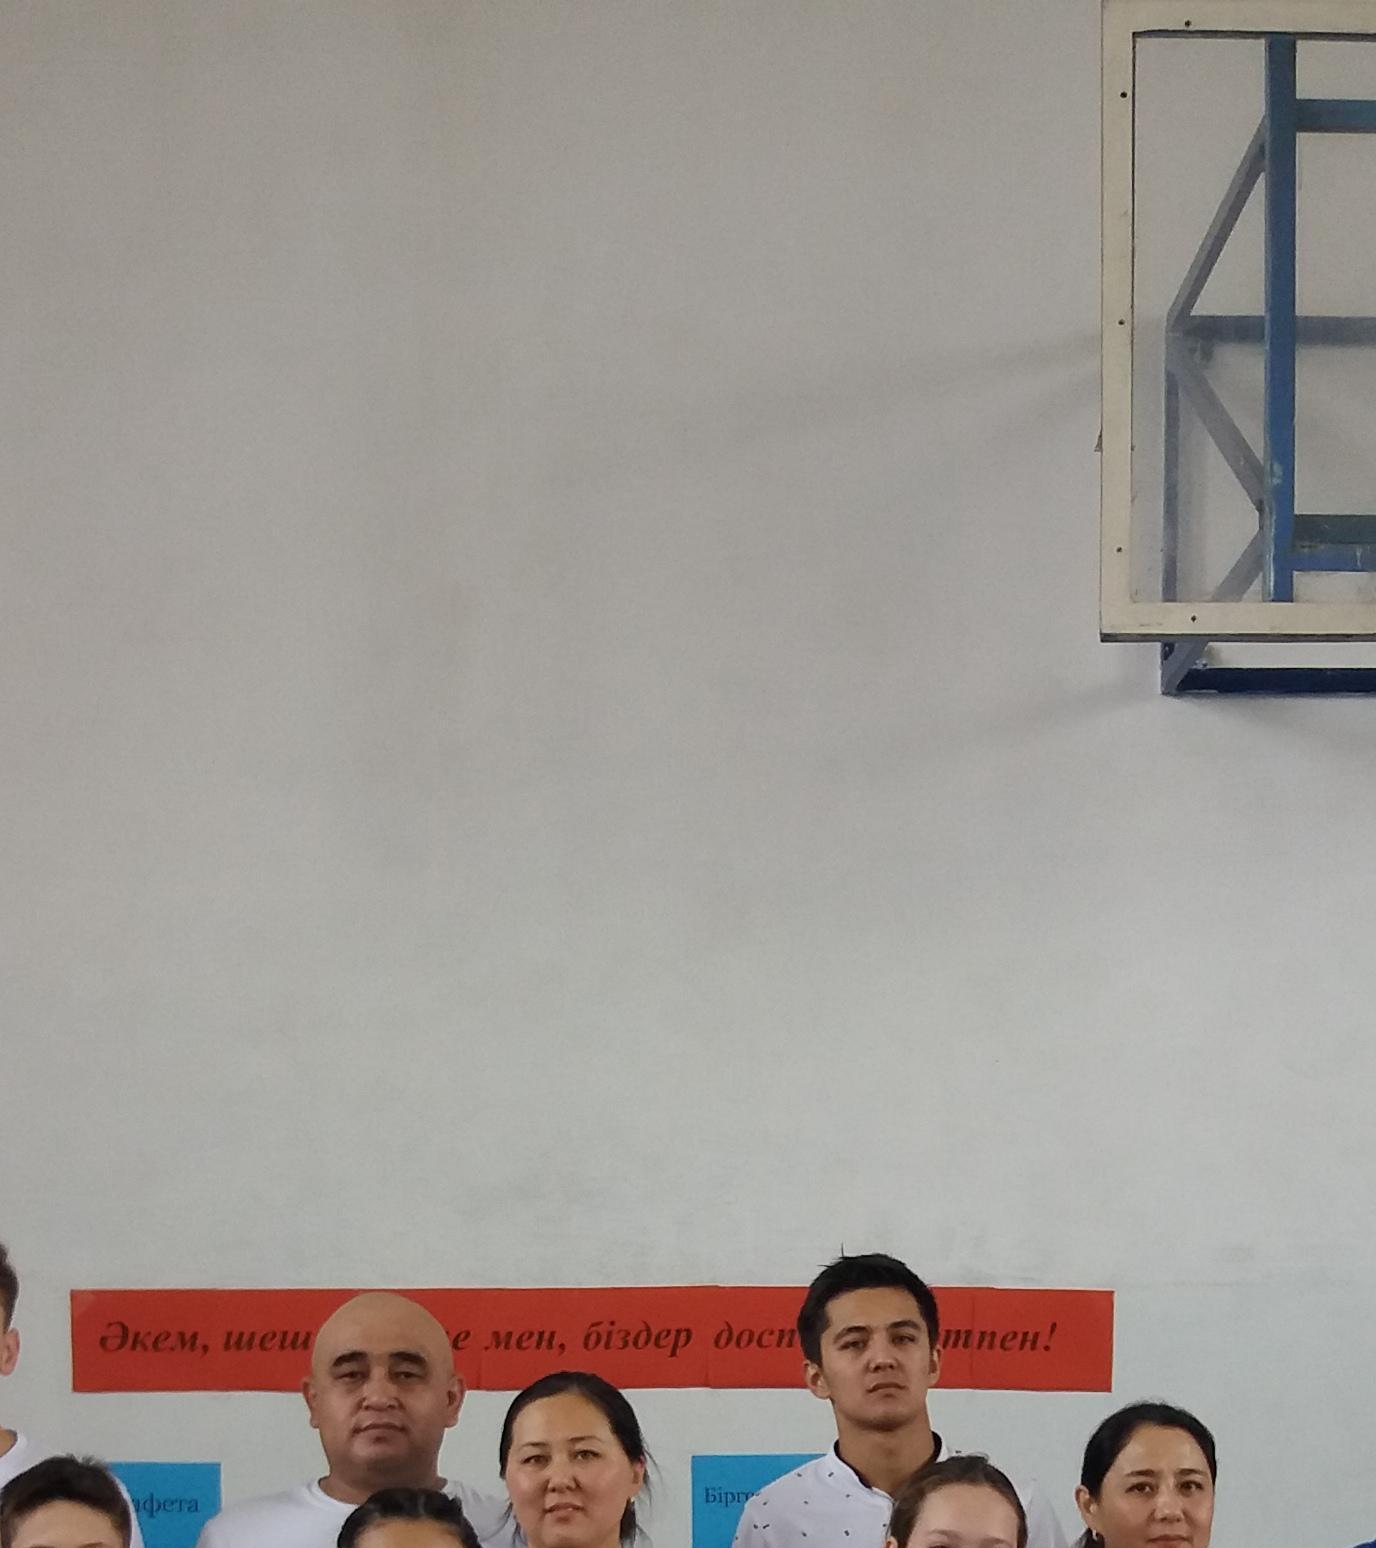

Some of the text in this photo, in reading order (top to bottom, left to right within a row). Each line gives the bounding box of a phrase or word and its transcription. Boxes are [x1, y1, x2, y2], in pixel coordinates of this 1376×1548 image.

[99, 1320, 209, 1358] Әкем,
[223, 1330, 313, 1352] шеш
[484, 1329, 567, 1355] мен,
[582, 1320, 693, 1358] біздер
[714, 1320, 797, 1350] досп
[941, 1322, 1057, 1352] тпен!
